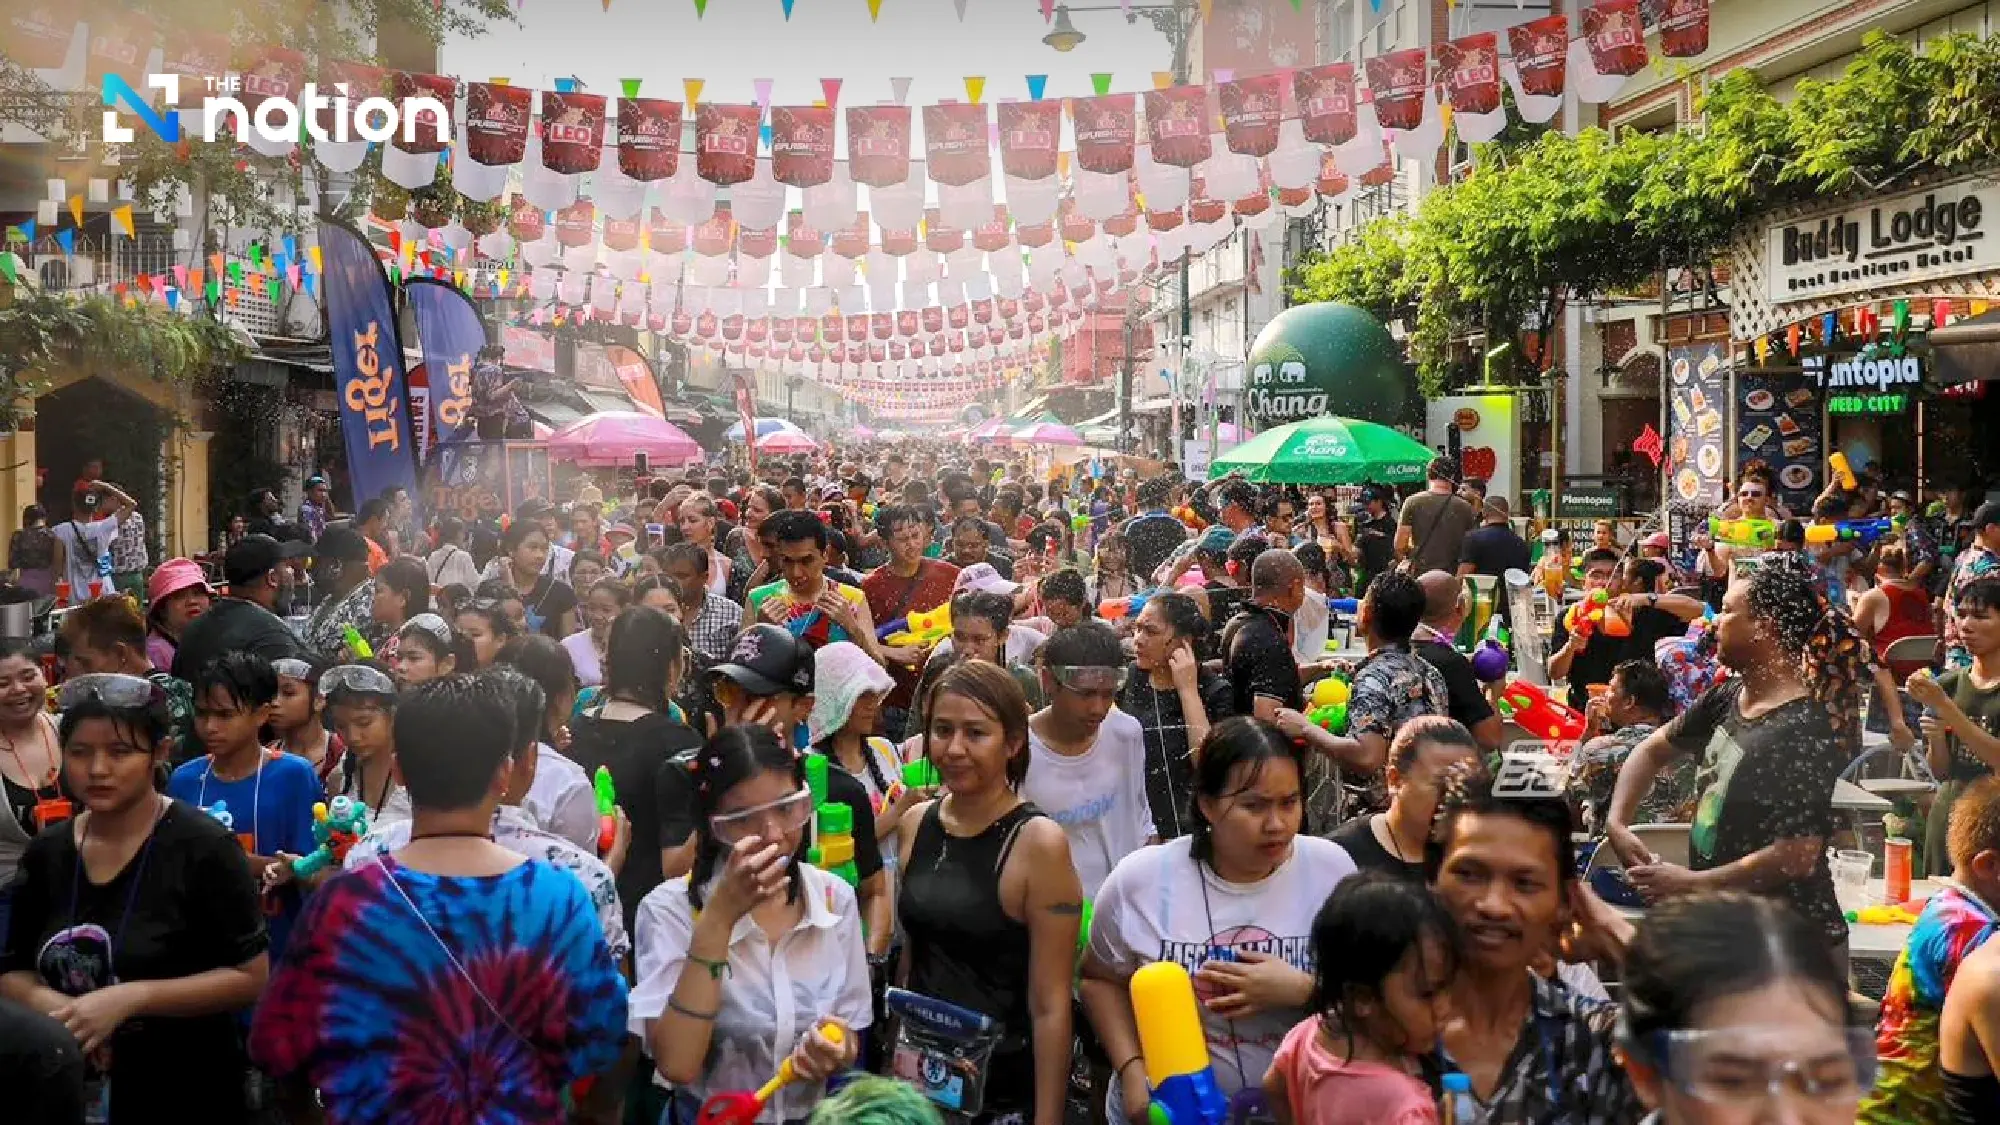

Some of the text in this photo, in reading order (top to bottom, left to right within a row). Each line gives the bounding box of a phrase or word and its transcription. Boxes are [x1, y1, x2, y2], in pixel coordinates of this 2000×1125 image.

[1455, 66, 1494, 88] LEO
[552, 124, 591, 143] LEO
[706, 135, 746, 153] LEO
[1783, 194, 1982, 266] Buddy Lodge
[1916, 245, 1973, 269] Hotel
[345, 320, 399, 451] Tiger
[440, 353, 473, 425] ger
[1249, 387, 1329, 419] Chang
[1868, 396, 1901, 412] CITY
[1294, 446, 1347, 457] Chang
[1562, 495, 1614, 506] Plantopia
[905, 1001, 963, 1029] CHELSEA
